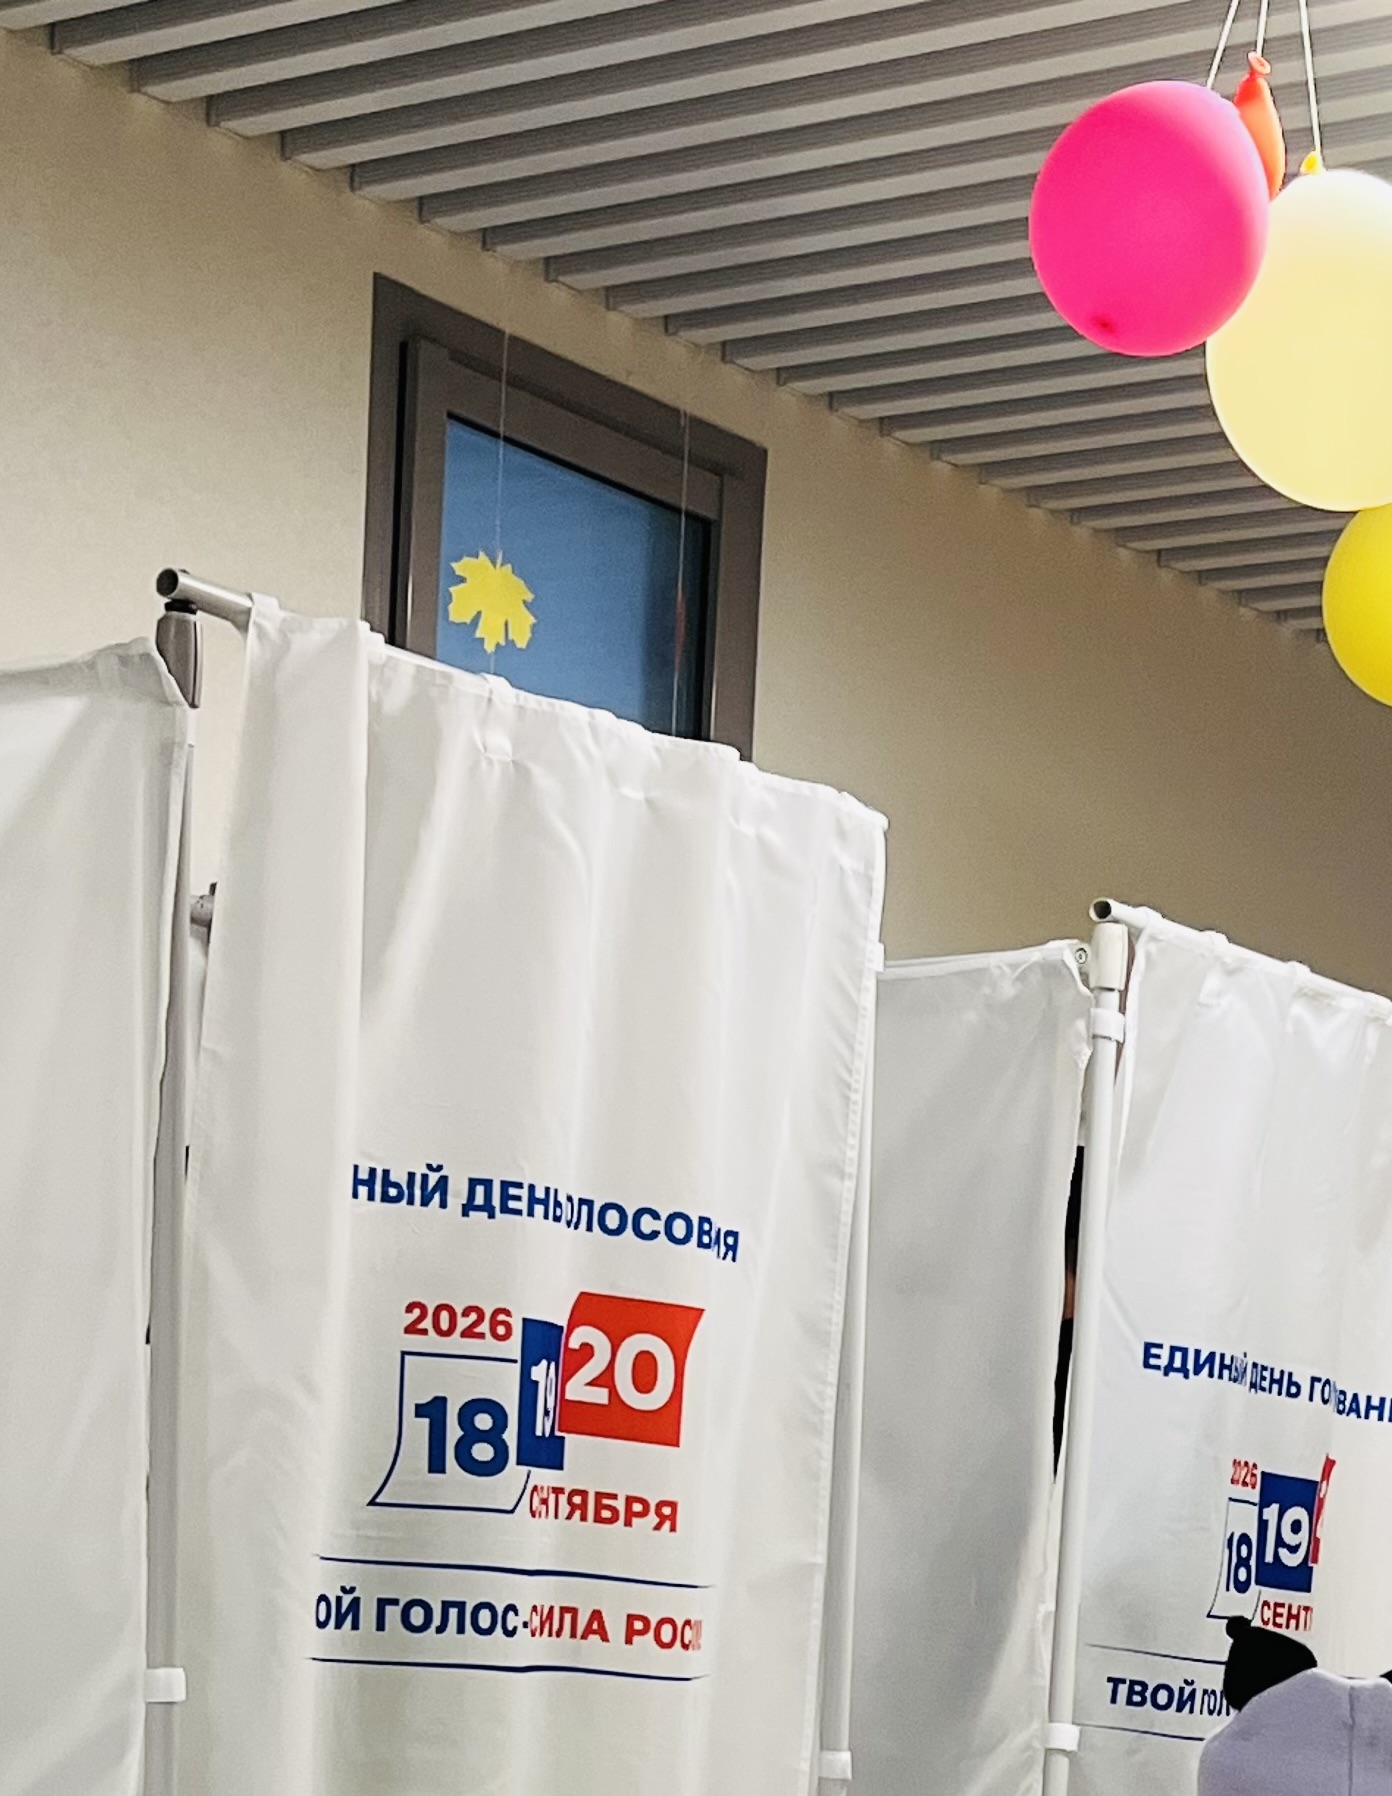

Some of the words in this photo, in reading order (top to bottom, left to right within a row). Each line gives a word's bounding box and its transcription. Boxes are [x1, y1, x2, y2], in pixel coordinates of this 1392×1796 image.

[352, 1163, 449, 1210] НЫЙ
[461, 1177, 563, 1224] ДЕНЬ
[404, 1300, 513, 1342] 2026
[565, 1325, 676, 1412] 20
[1249, 1361, 1302, 1399] ДЕНЬ
[414, 1395, 510, 1478] 18
[1226, 1531, 1253, 1594] 18
[1262, 1503, 1310, 1568] 19
[315, 1585, 361, 1632] ОЙ
[625, 1613, 703, 1652] РОС
[1260, 1600, 1314, 1631] СЕНТ
[1106, 1676, 1197, 1715] ТВОЙ
